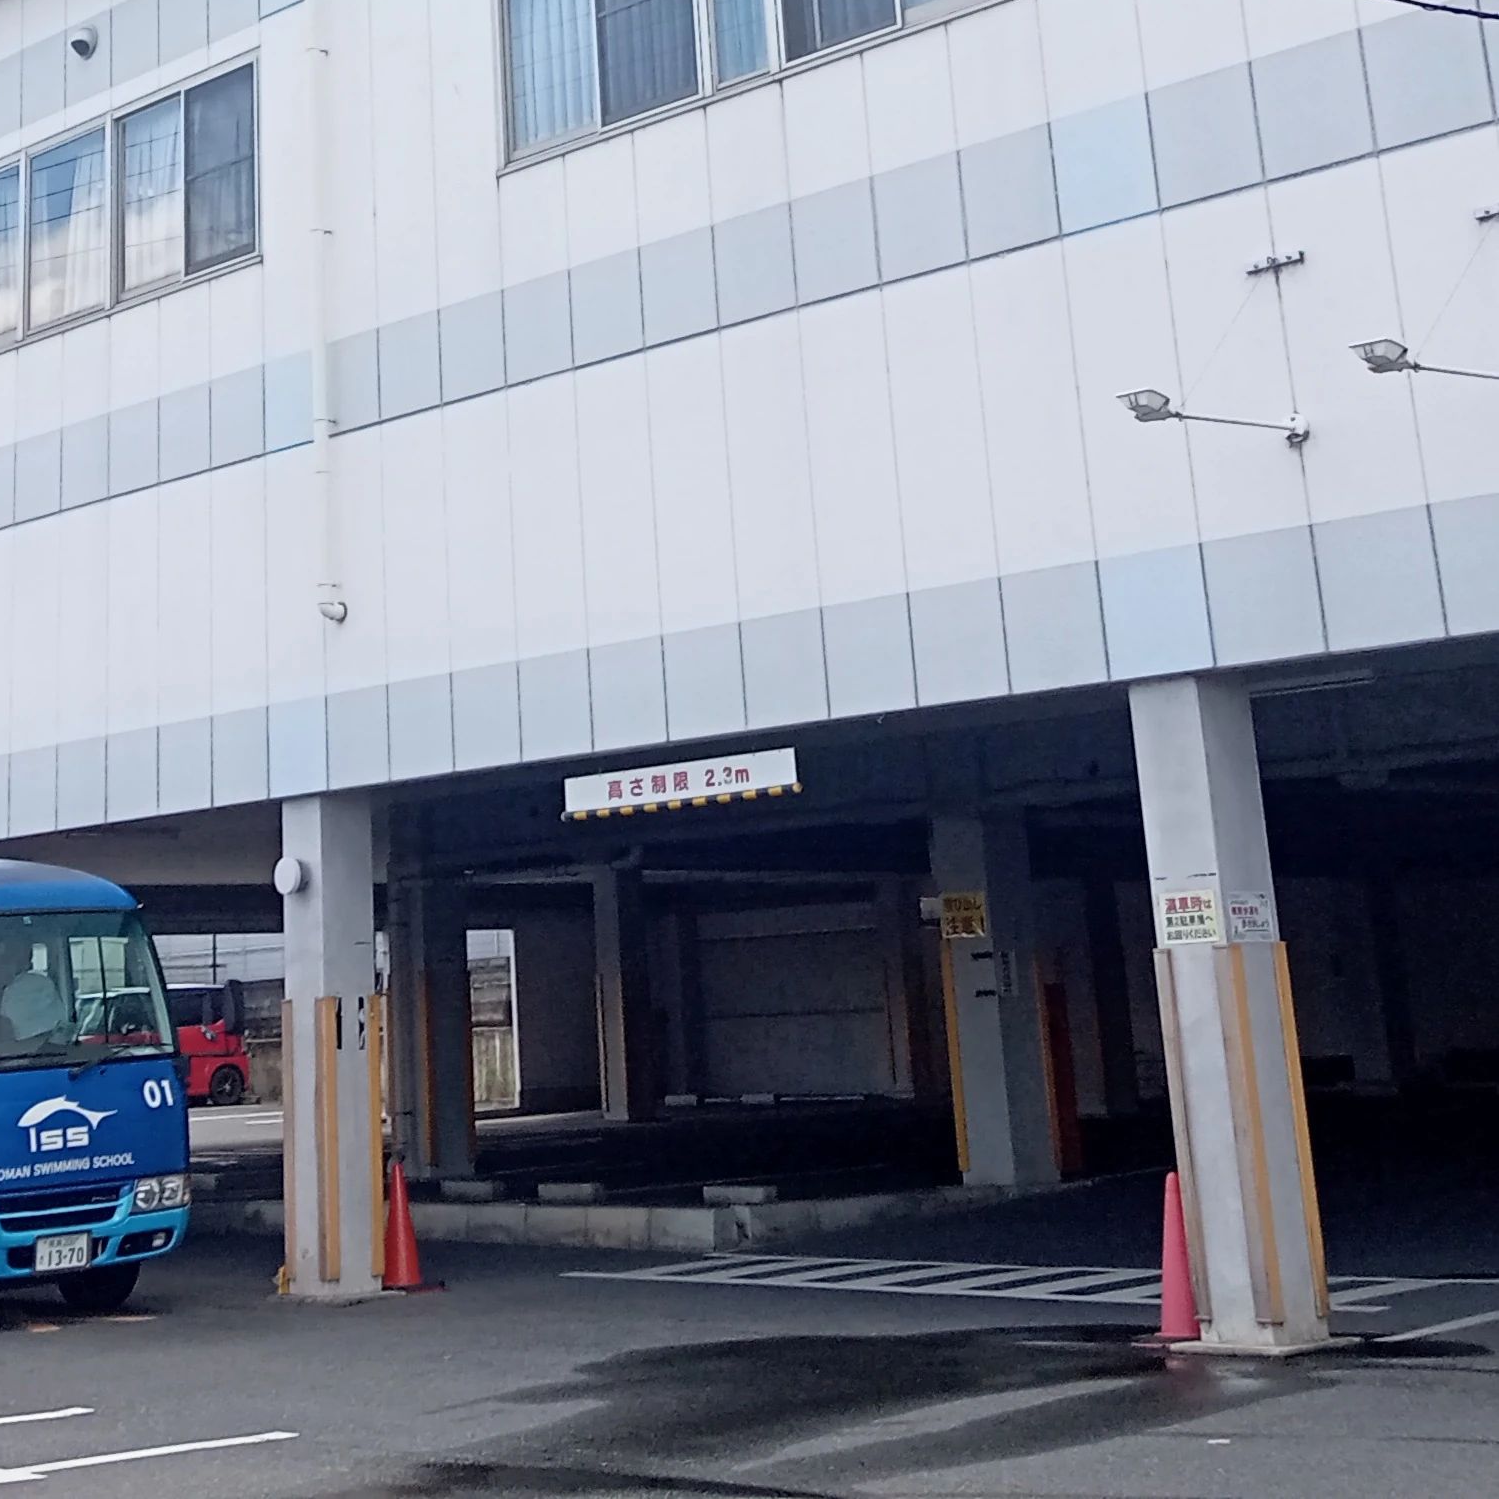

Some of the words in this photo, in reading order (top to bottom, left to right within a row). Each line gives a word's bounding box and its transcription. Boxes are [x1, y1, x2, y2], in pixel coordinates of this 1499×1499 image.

[607, 771, 689, 800] 高さ制限
[1165, 896, 1212, 913] 満車時は
[143, 1078, 174, 1109] 01
[29, 1125, 90, 1153] ISS
[33, 1156, 91, 1177] SWIMMING
[92, 1152, 135, 1169] SCHOOL
[47, 1246, 84, 1267] 13-70
